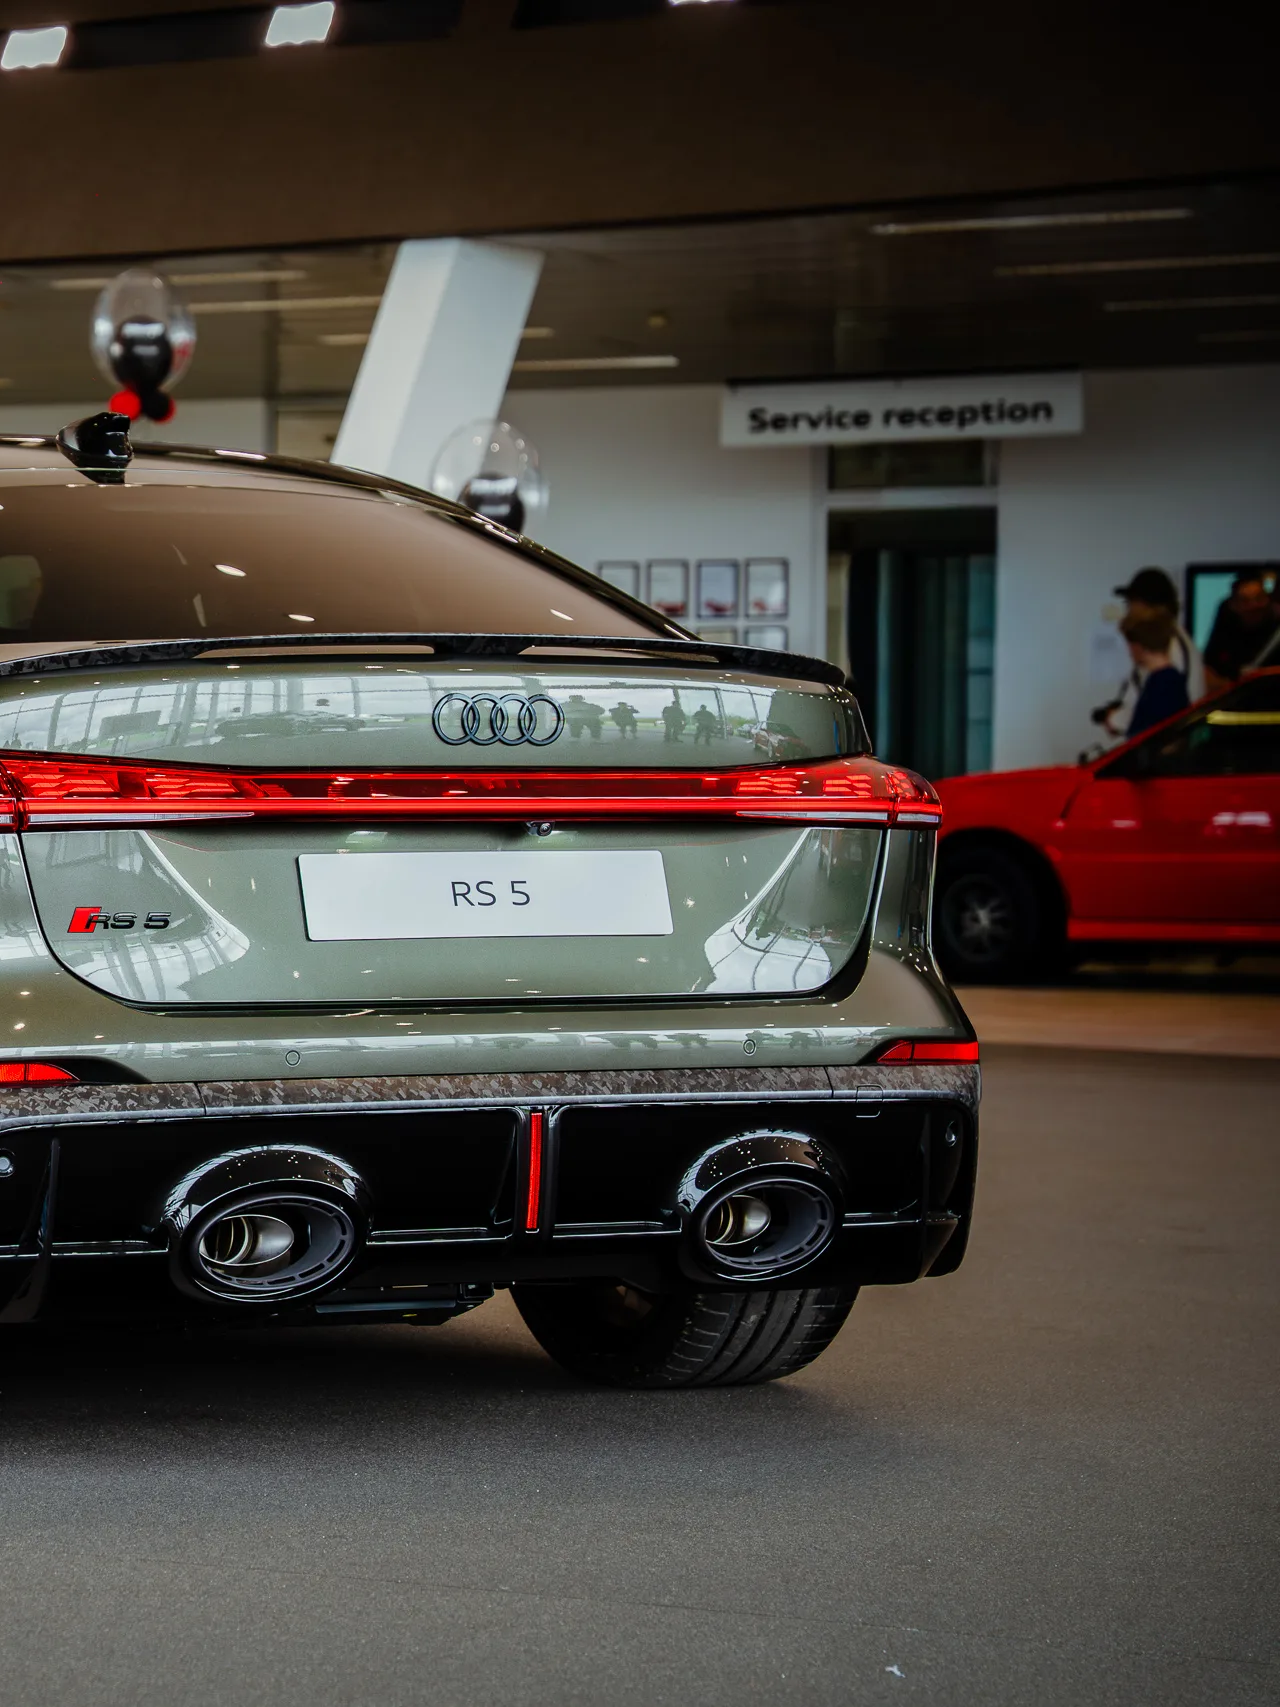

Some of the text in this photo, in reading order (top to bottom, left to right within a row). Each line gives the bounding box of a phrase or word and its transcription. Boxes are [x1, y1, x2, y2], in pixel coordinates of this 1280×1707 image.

[748, 397, 1054, 434] Service reception
[451, 880, 531, 906] RS 5
[83, 911, 172, 930] RS 5
